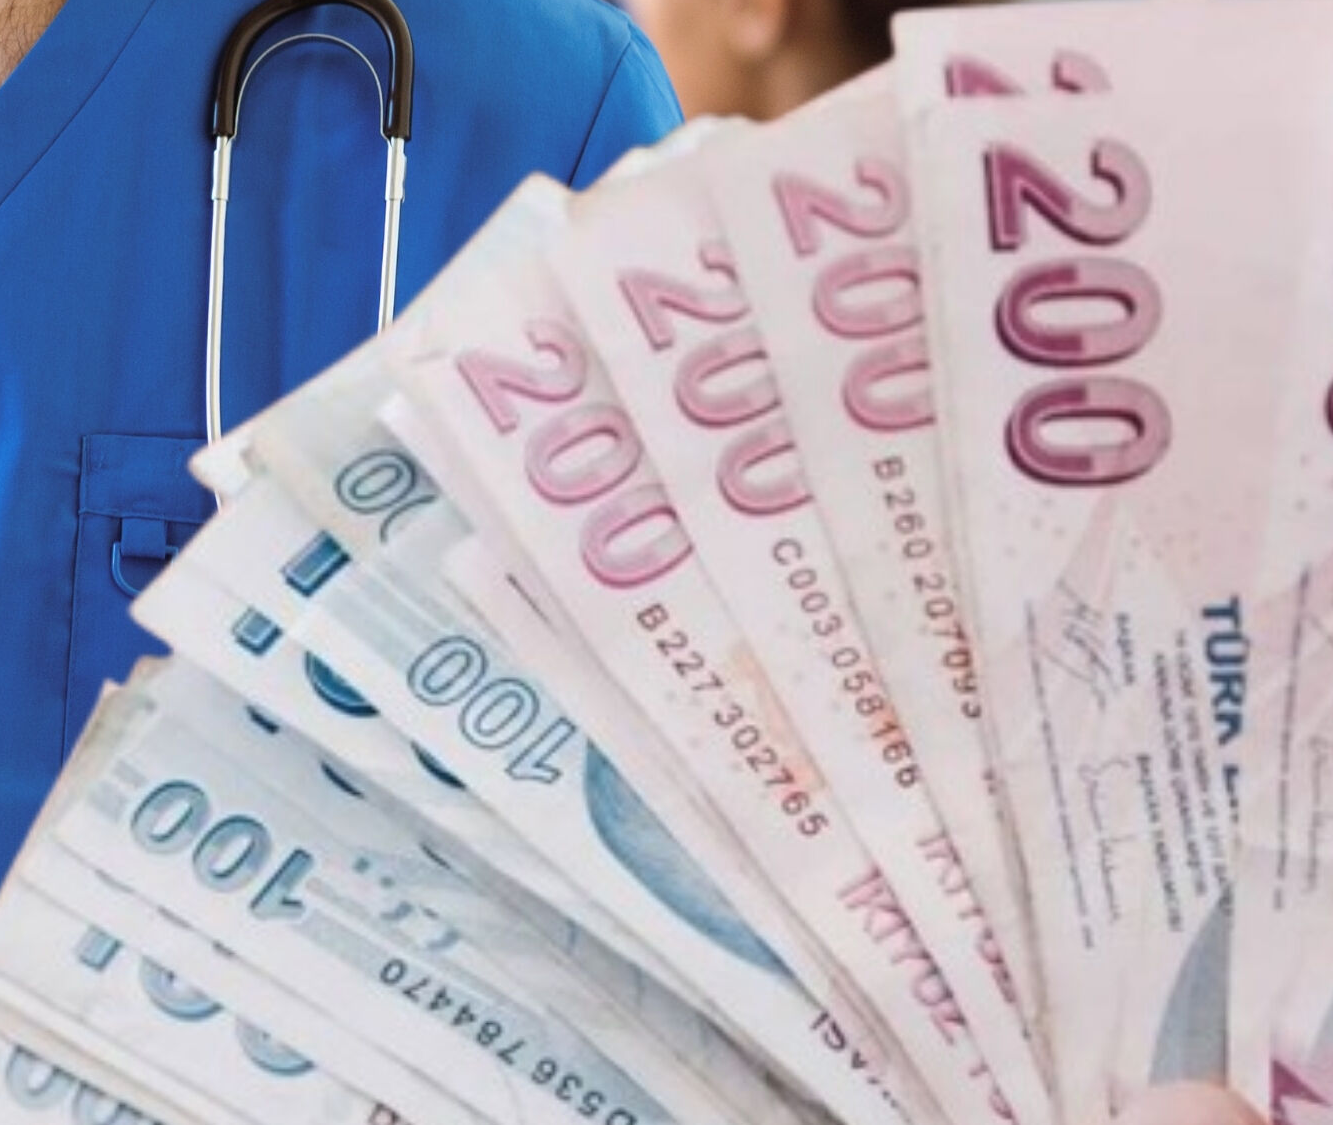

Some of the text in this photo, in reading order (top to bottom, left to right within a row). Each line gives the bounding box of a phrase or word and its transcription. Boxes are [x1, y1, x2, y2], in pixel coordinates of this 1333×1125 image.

[618, 240, 814, 515] 200
[771, 156, 935, 433] 200
[983, 137, 1173, 488] 200
[456, 319, 694, 589] 200
[771, 538, 844, 637] C003
[407, 635, 577, 784] 100
[637, 602, 829, 838] B227 302765
[130, 779, 314, 919] 100
[381, 959, 529, 1066] 784470
